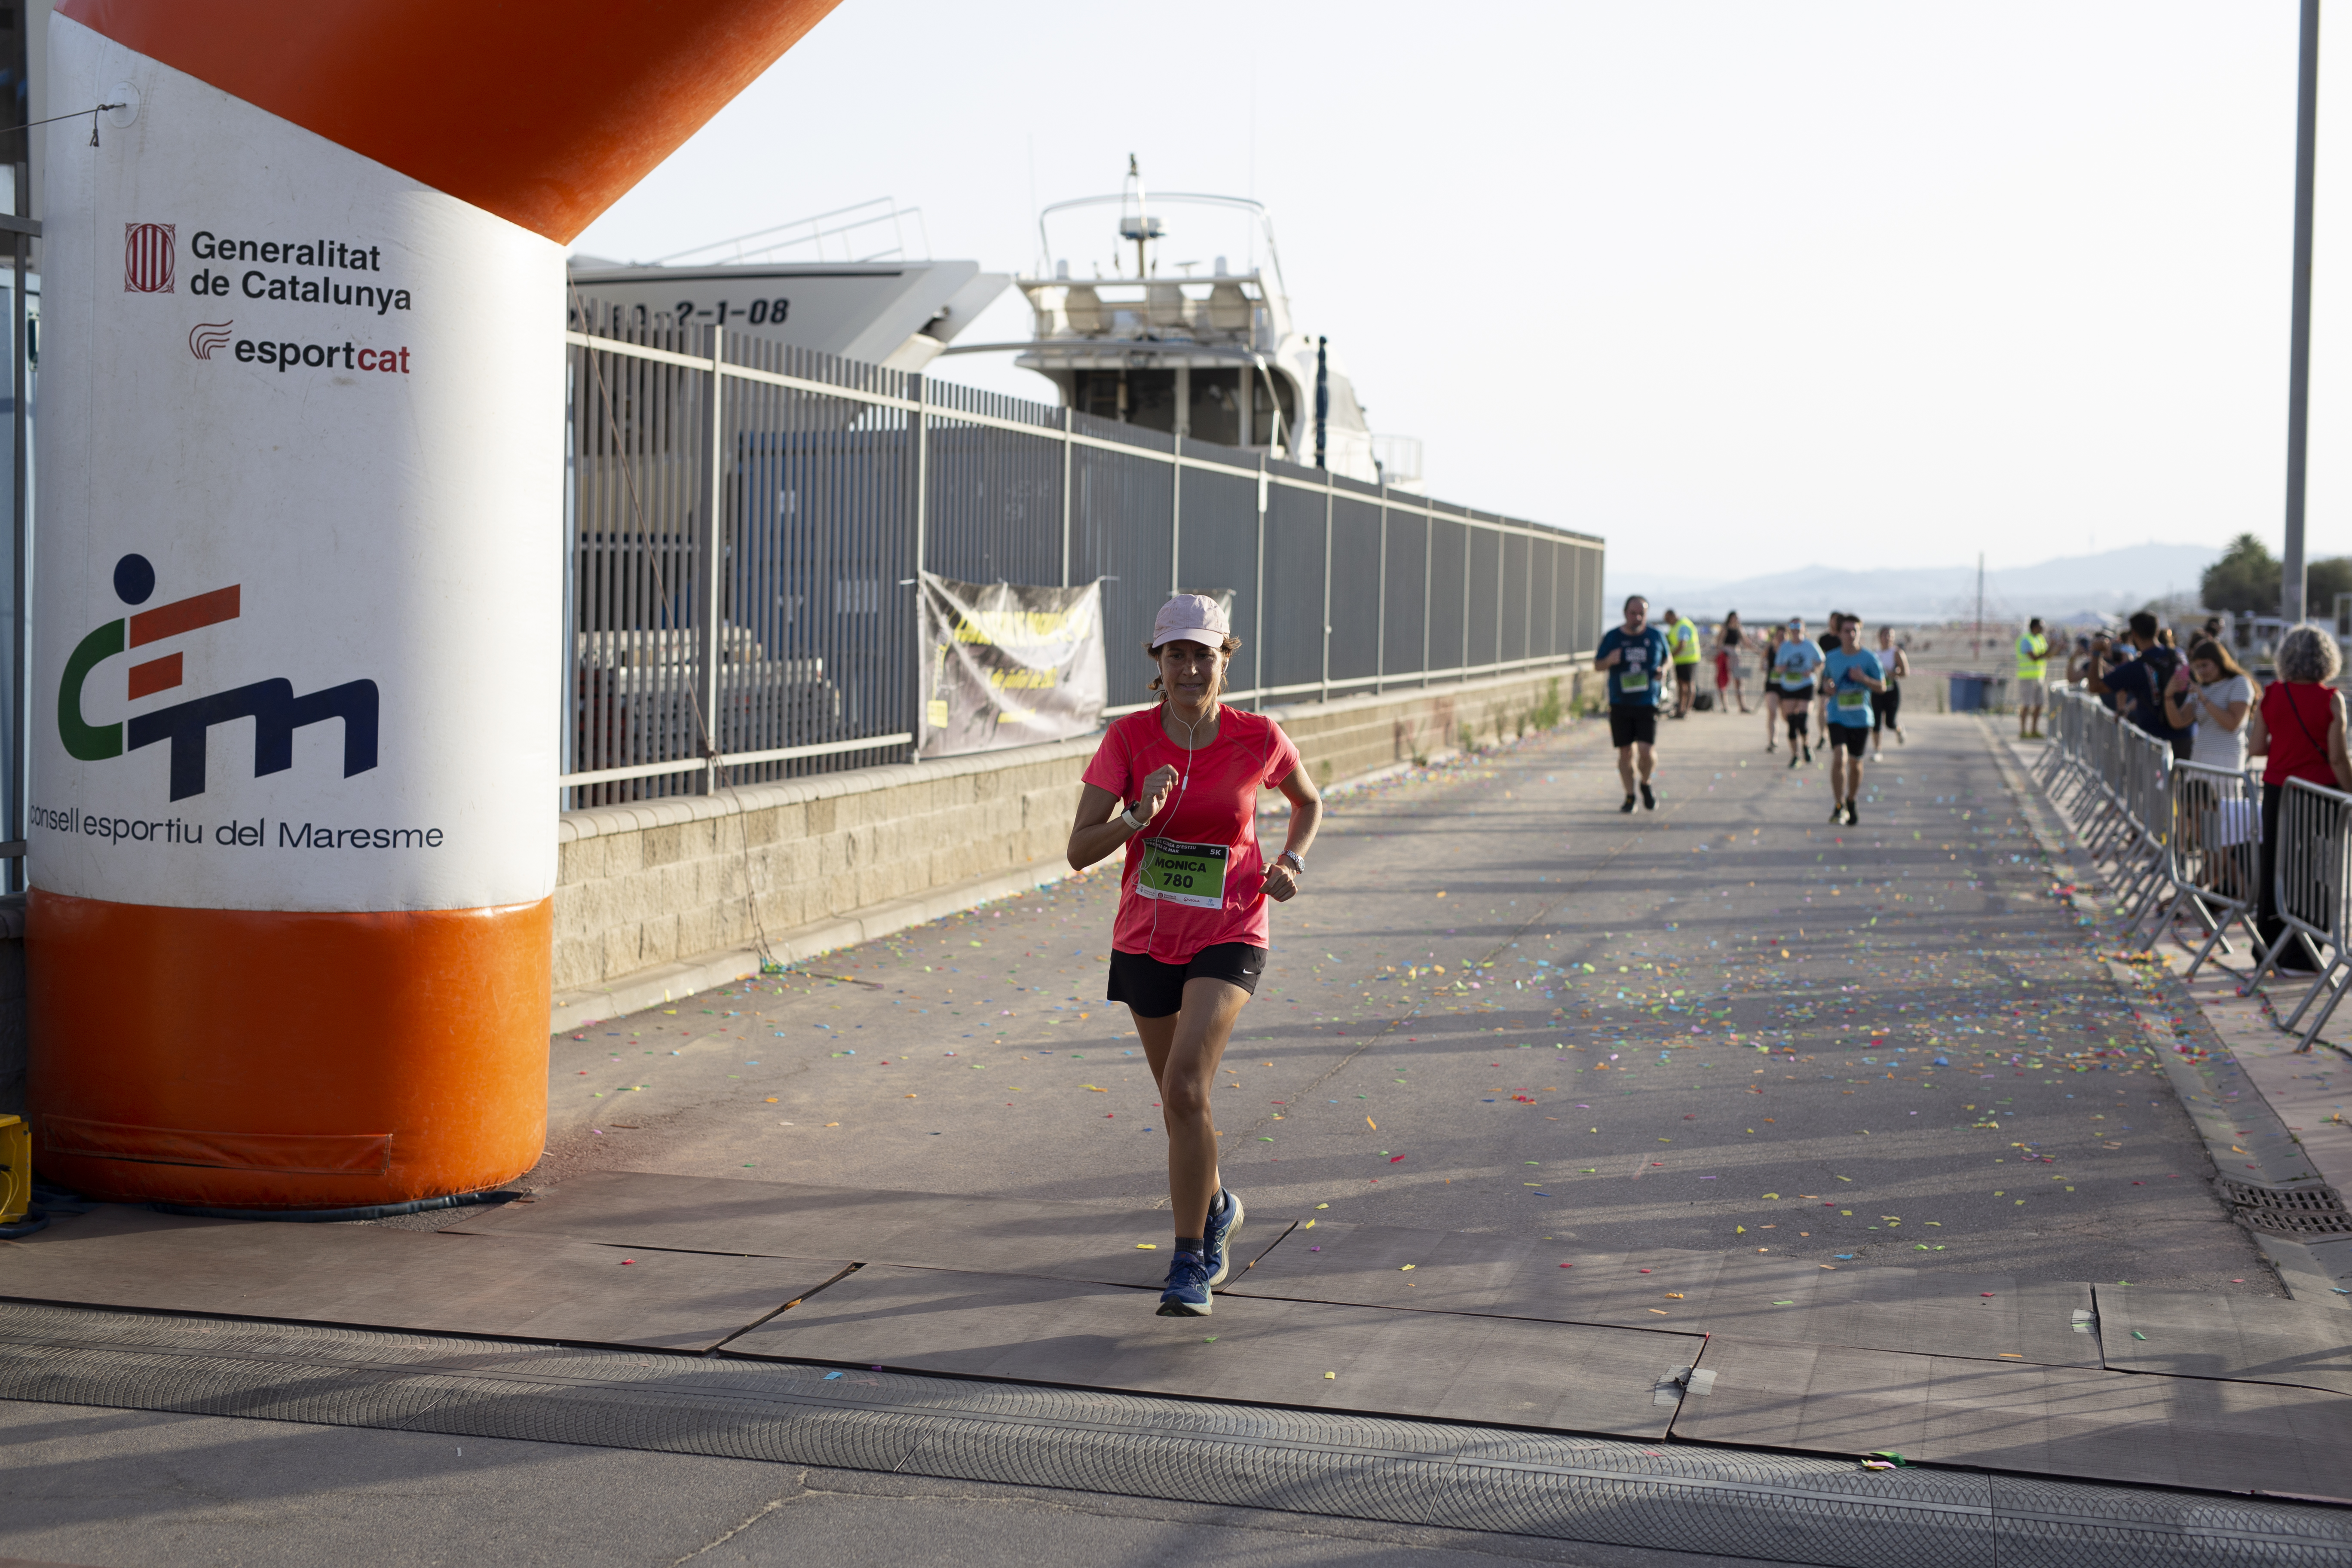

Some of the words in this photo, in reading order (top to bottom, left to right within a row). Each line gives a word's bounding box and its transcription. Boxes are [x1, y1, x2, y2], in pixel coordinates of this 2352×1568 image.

[191, 231, 381, 272] Generalitat
[190, 269, 230, 296] de
[242, 271, 411, 315] Catalunya
[235, 339, 410, 374] esportcat
[31, 805, 79, 833] consell
[83, 815, 202, 846] esportiu
[215, 817, 264, 847] del
[279, 822, 444, 848] Maresme
[1155, 856, 1207, 873] MONICA
[1163, 873, 1193, 888] 780
